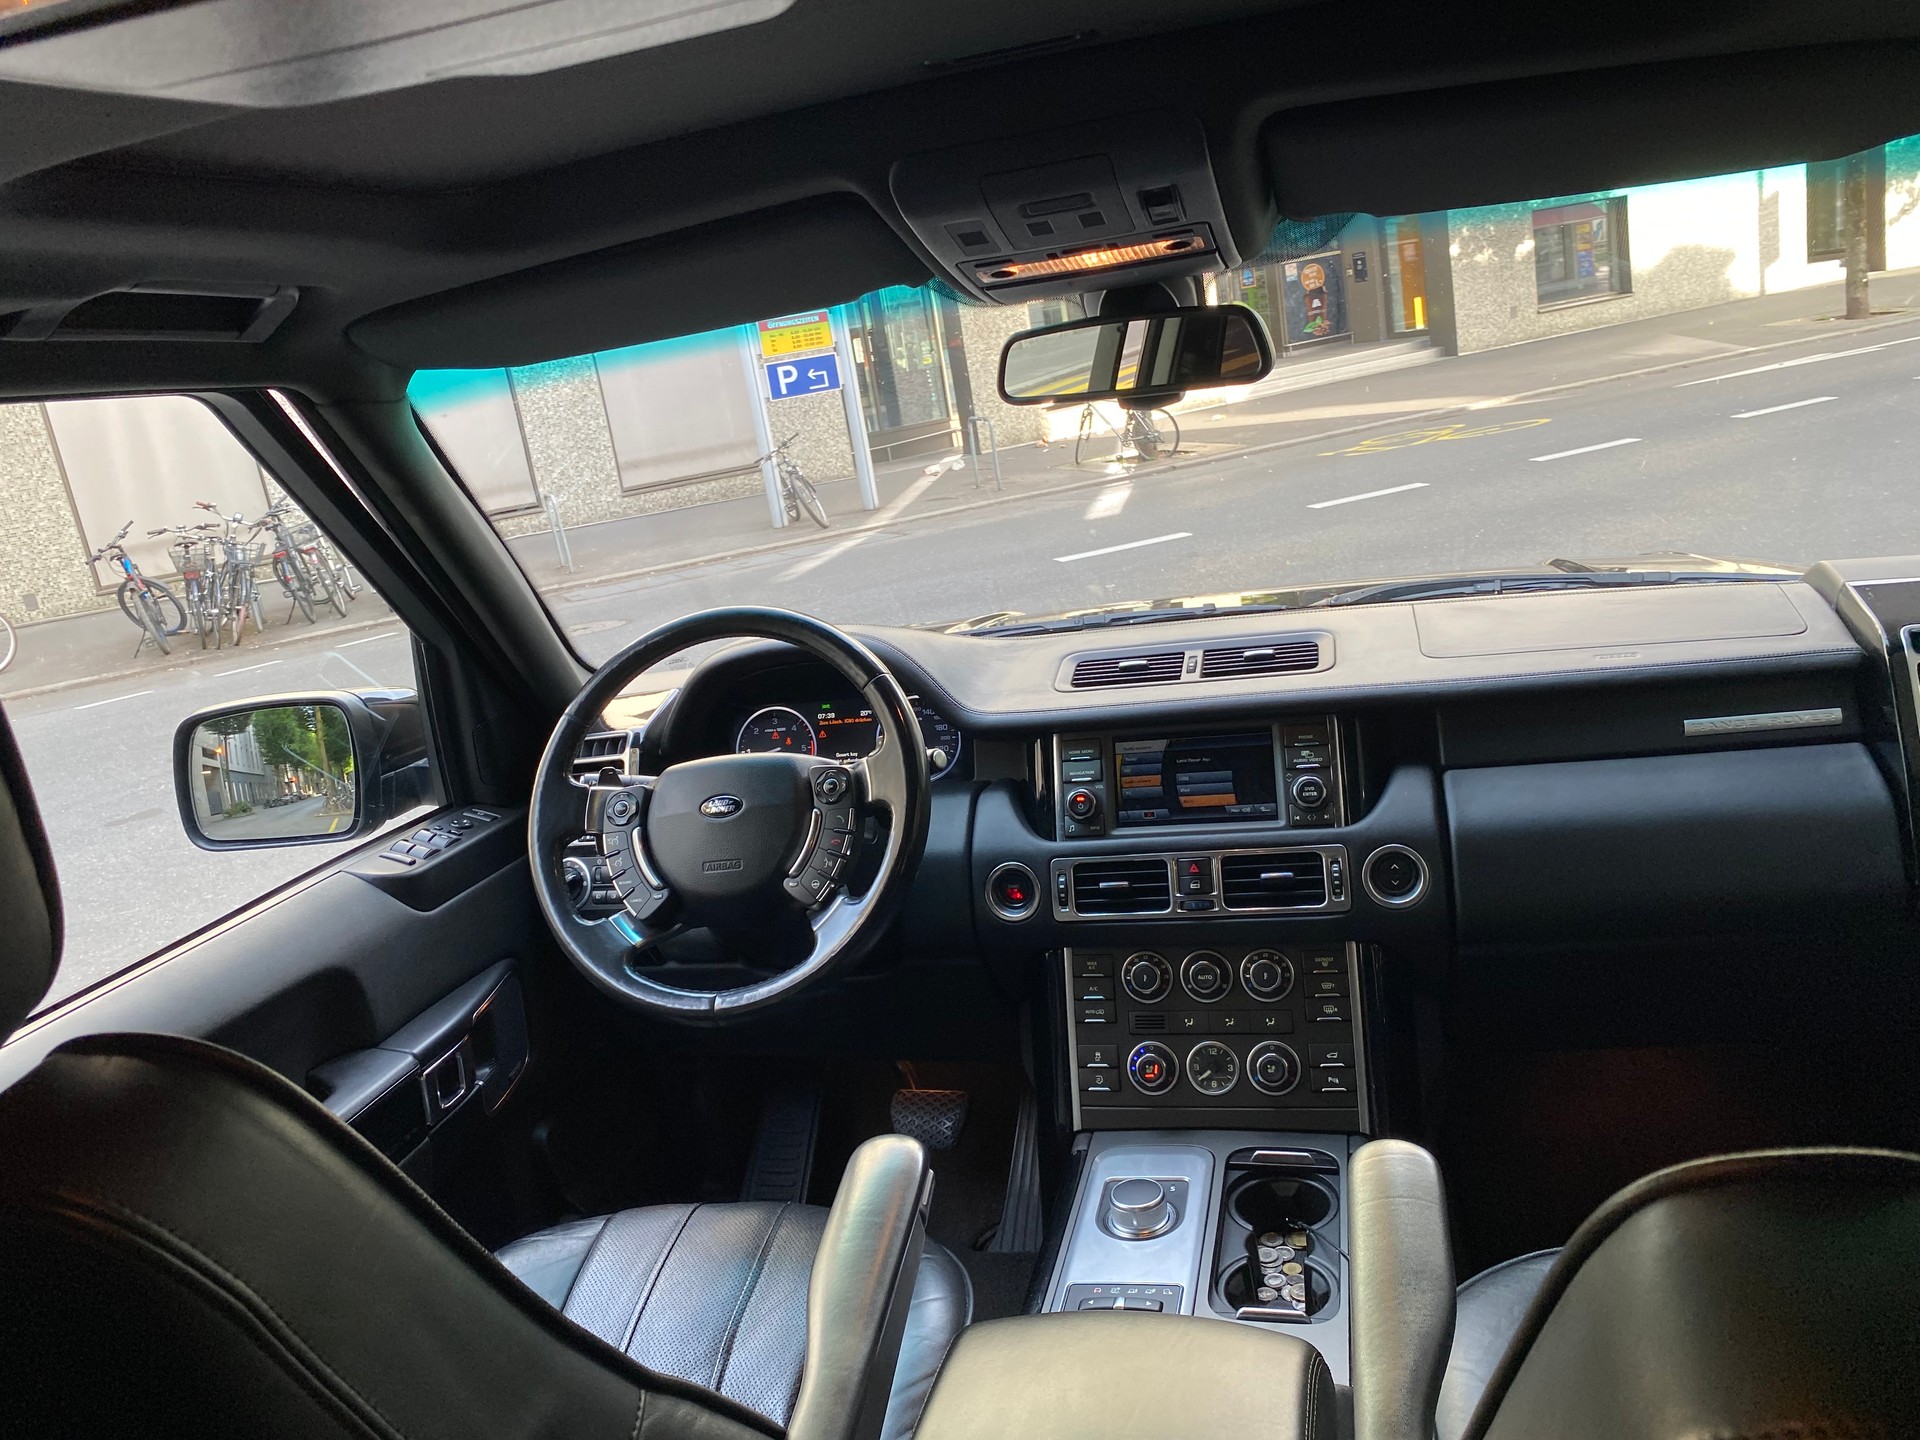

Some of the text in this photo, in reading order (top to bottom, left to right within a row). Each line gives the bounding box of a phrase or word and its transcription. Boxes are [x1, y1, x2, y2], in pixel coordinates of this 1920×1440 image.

[777, 365, 798, 394] P
[1691, 712, 1836, 732] RANGE ROVER
[710, 805, 735, 814] ROVER
[706, 861, 740, 872] AIRBAG
